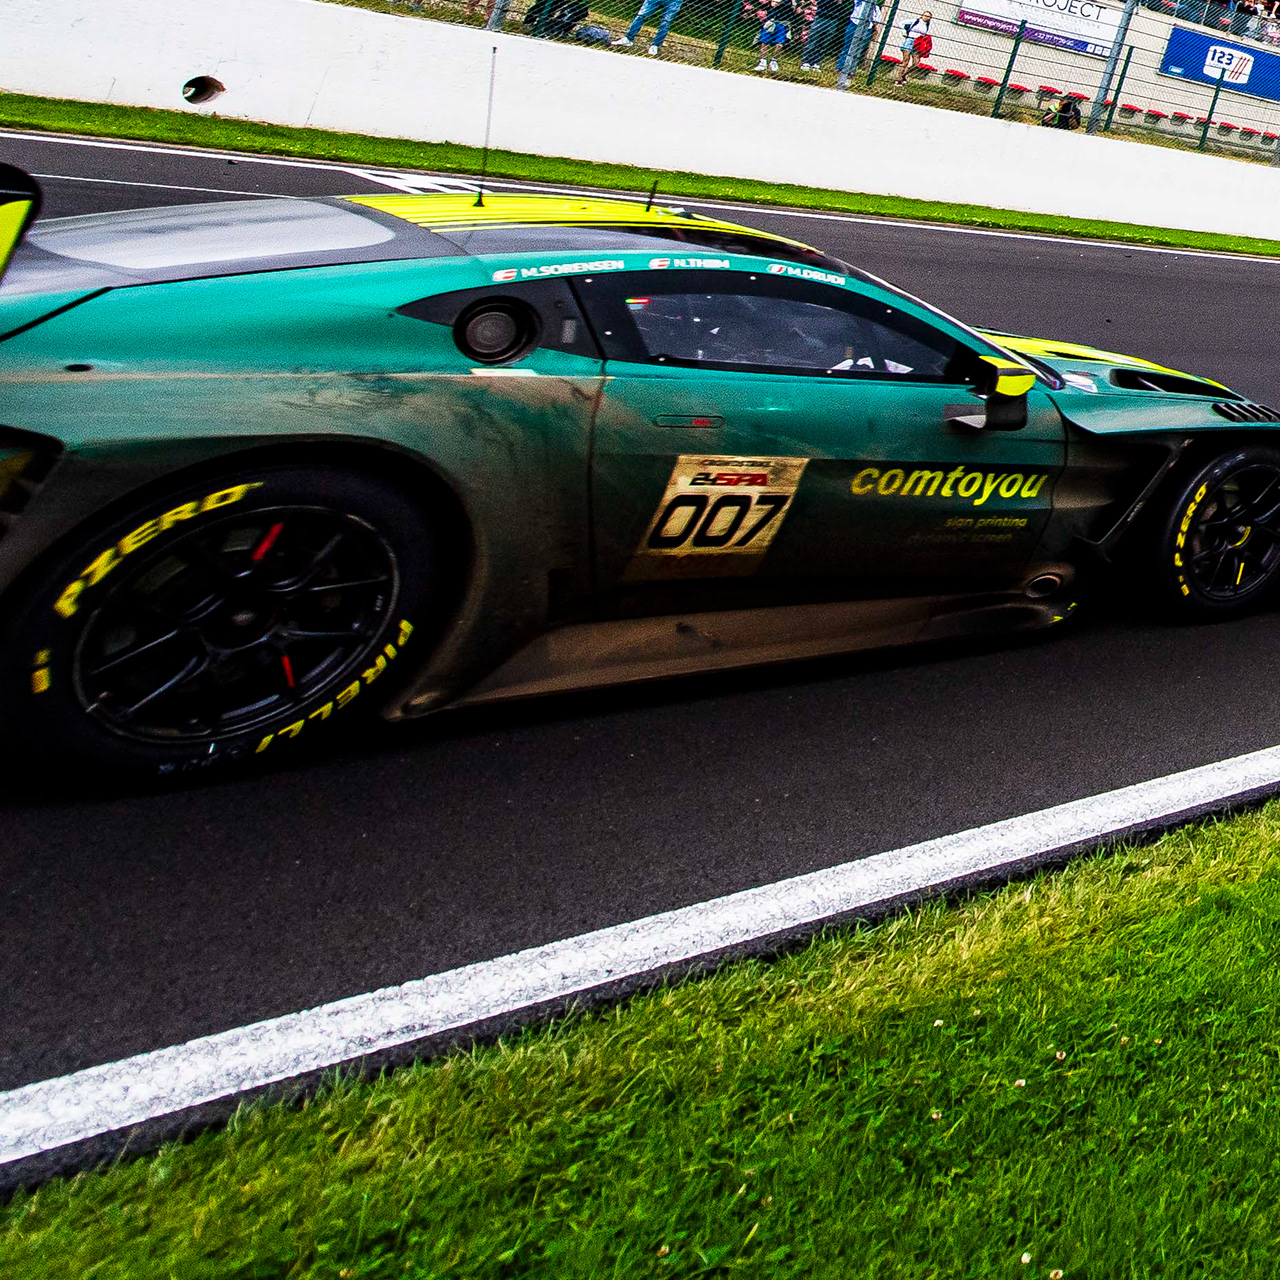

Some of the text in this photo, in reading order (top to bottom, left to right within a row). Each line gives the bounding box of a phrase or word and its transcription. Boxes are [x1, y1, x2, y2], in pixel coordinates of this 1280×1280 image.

[1210, 48, 1234, 66] 123
[786, 265, 846, 286] M.DRUDI
[850, 465, 1049, 506] comtoyou
[648, 493, 791, 548] 007
[975, 514, 1028, 530] printing
[255, 619, 414, 754] PIRELLI
